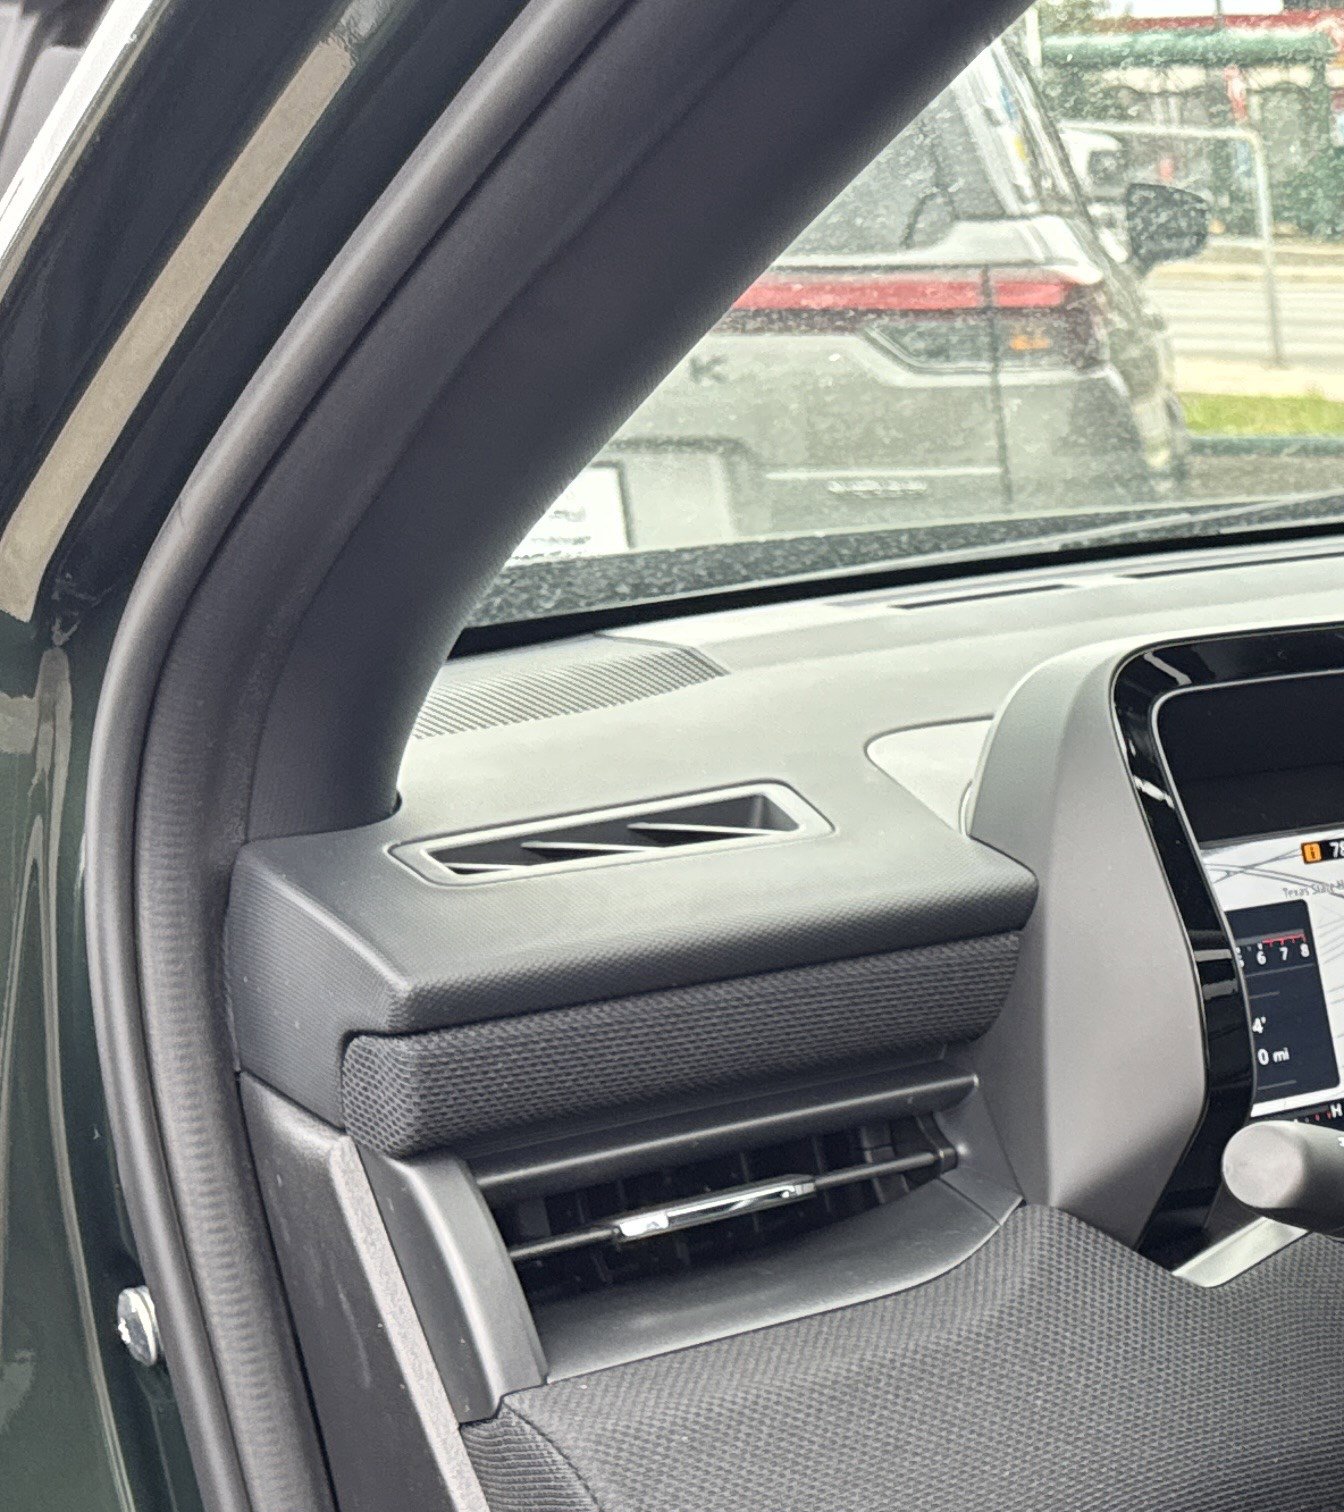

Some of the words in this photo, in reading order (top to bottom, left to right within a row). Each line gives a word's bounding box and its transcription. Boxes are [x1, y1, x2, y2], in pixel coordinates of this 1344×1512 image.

[1282, 886, 1309, 899] Texas
[1256, 951, 1267, 965] 6
[1279, 946, 1288, 961] 7
[1300, 943, 1310, 958] 8
[1272, 1046, 1290, 1063] mi
[1329, 1103, 1343, 1118] H
